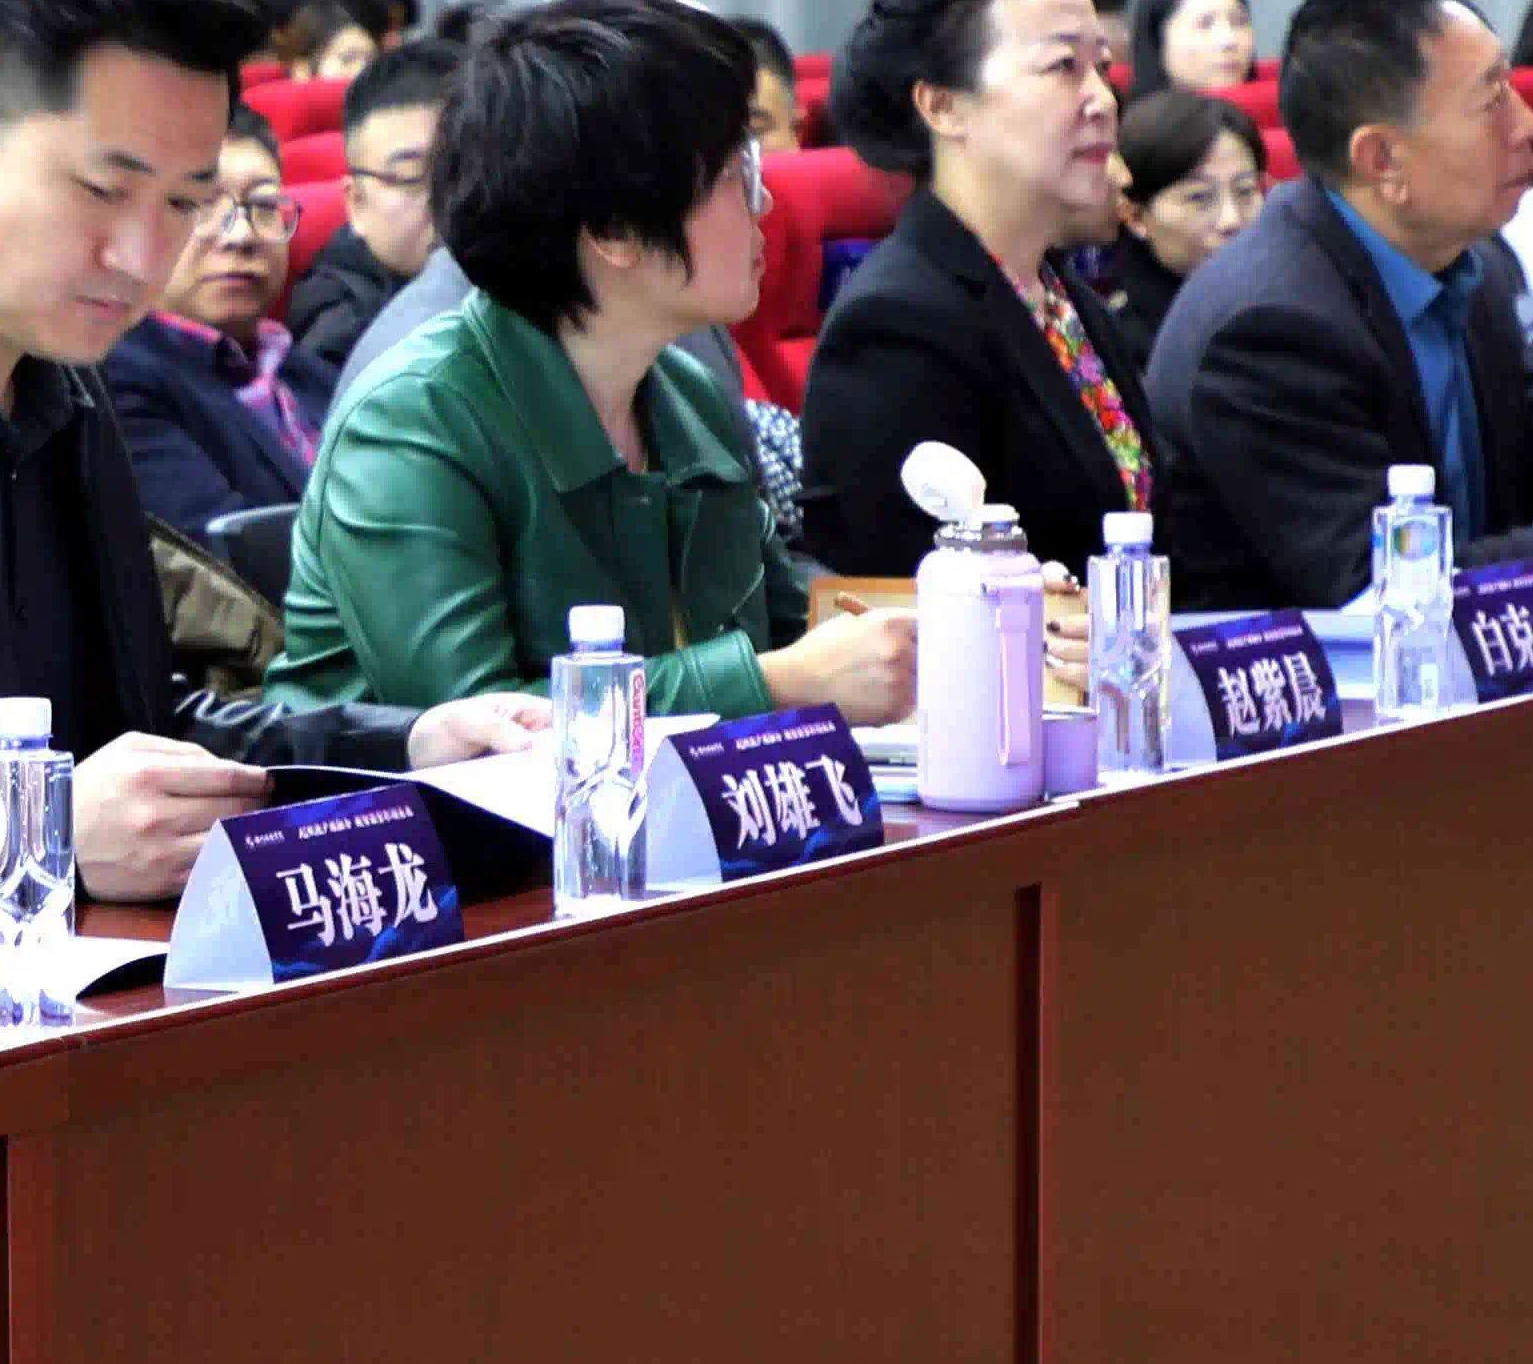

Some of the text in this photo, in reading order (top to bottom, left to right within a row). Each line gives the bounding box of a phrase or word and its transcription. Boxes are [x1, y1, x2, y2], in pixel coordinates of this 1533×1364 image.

[1216, 650, 1328, 740] 赵紫晨
[721, 754, 864, 850] 刘雄飞
[275, 842, 440, 948] 马海龙
